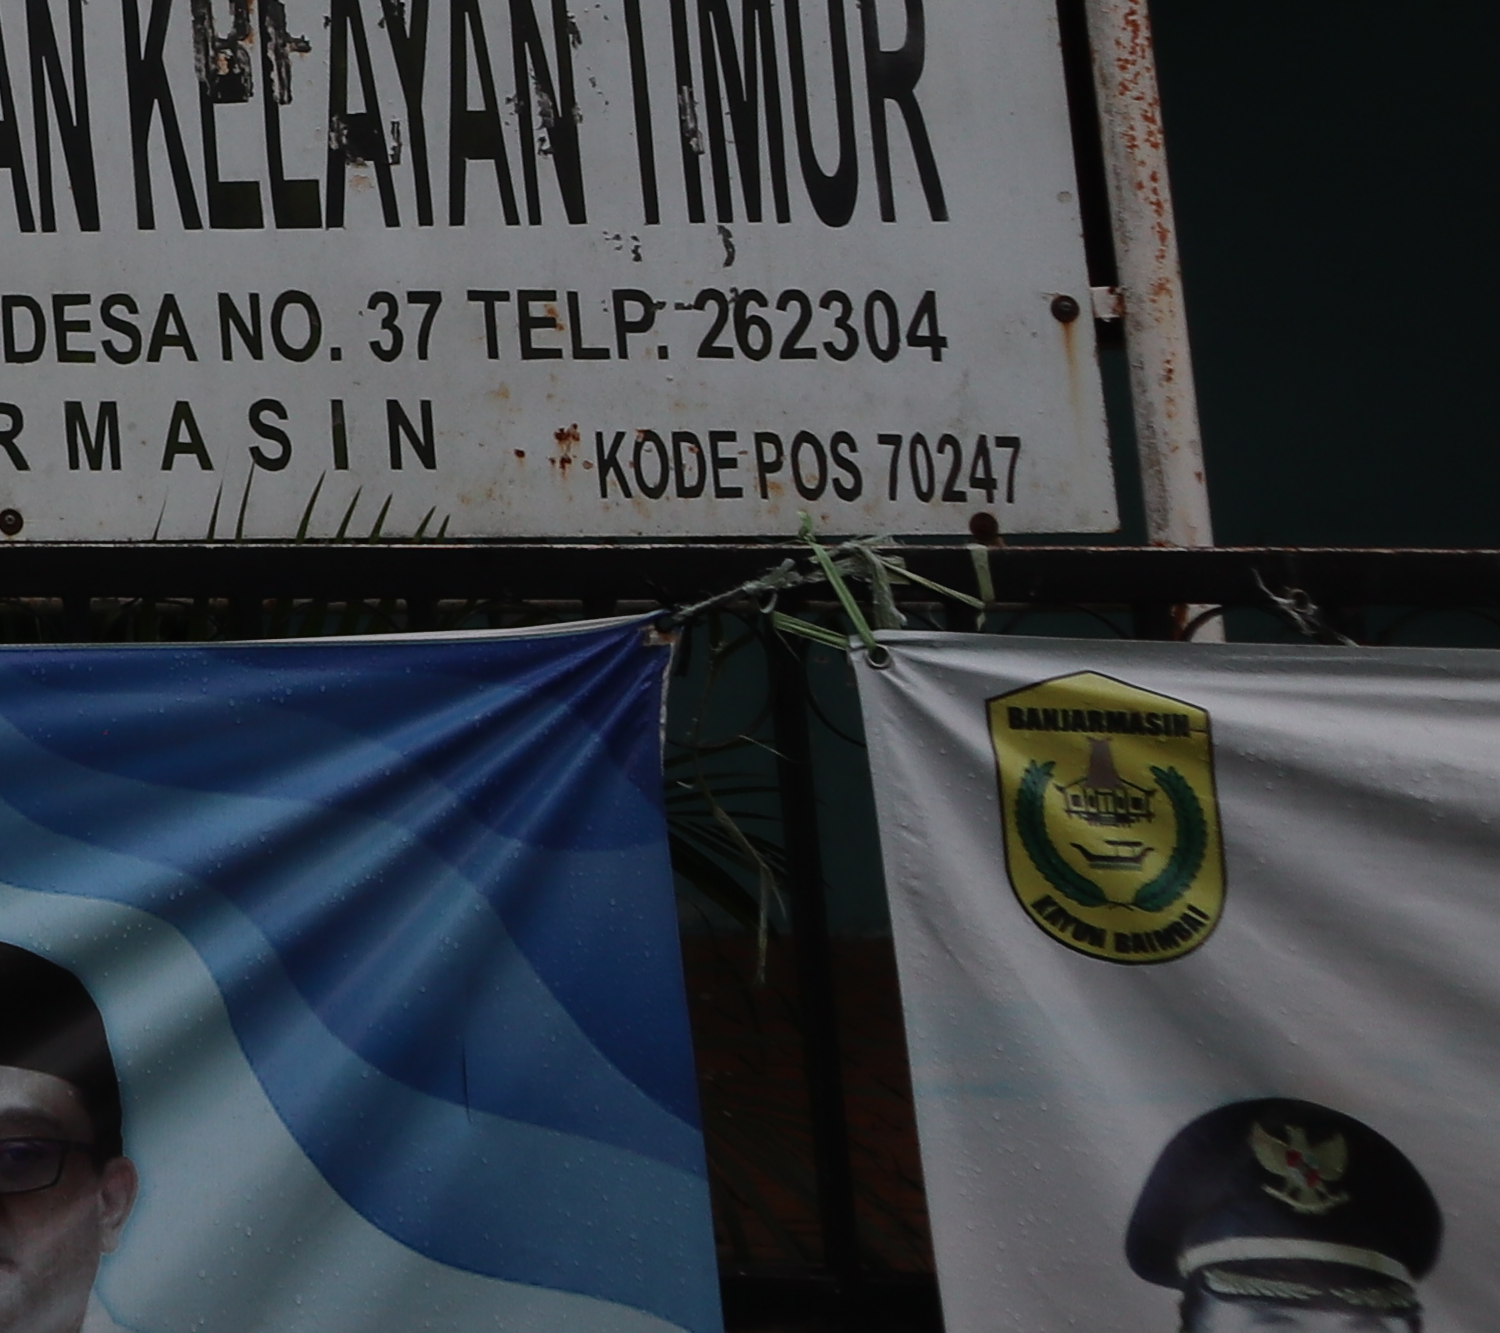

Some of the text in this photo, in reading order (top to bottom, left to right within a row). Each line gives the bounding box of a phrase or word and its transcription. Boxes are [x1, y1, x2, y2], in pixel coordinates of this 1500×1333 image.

[1, 291, 200, 365] DESA
[217, 290, 342, 361] NO.
[367, 290, 443, 361] 37
[466, 289, 668, 361] TELP.
[696, 288, 948, 362] 262304
[594, 429, 1021, 504] KODE POS 70247
[1008, 707, 1190, 737] BANJARMASIN
